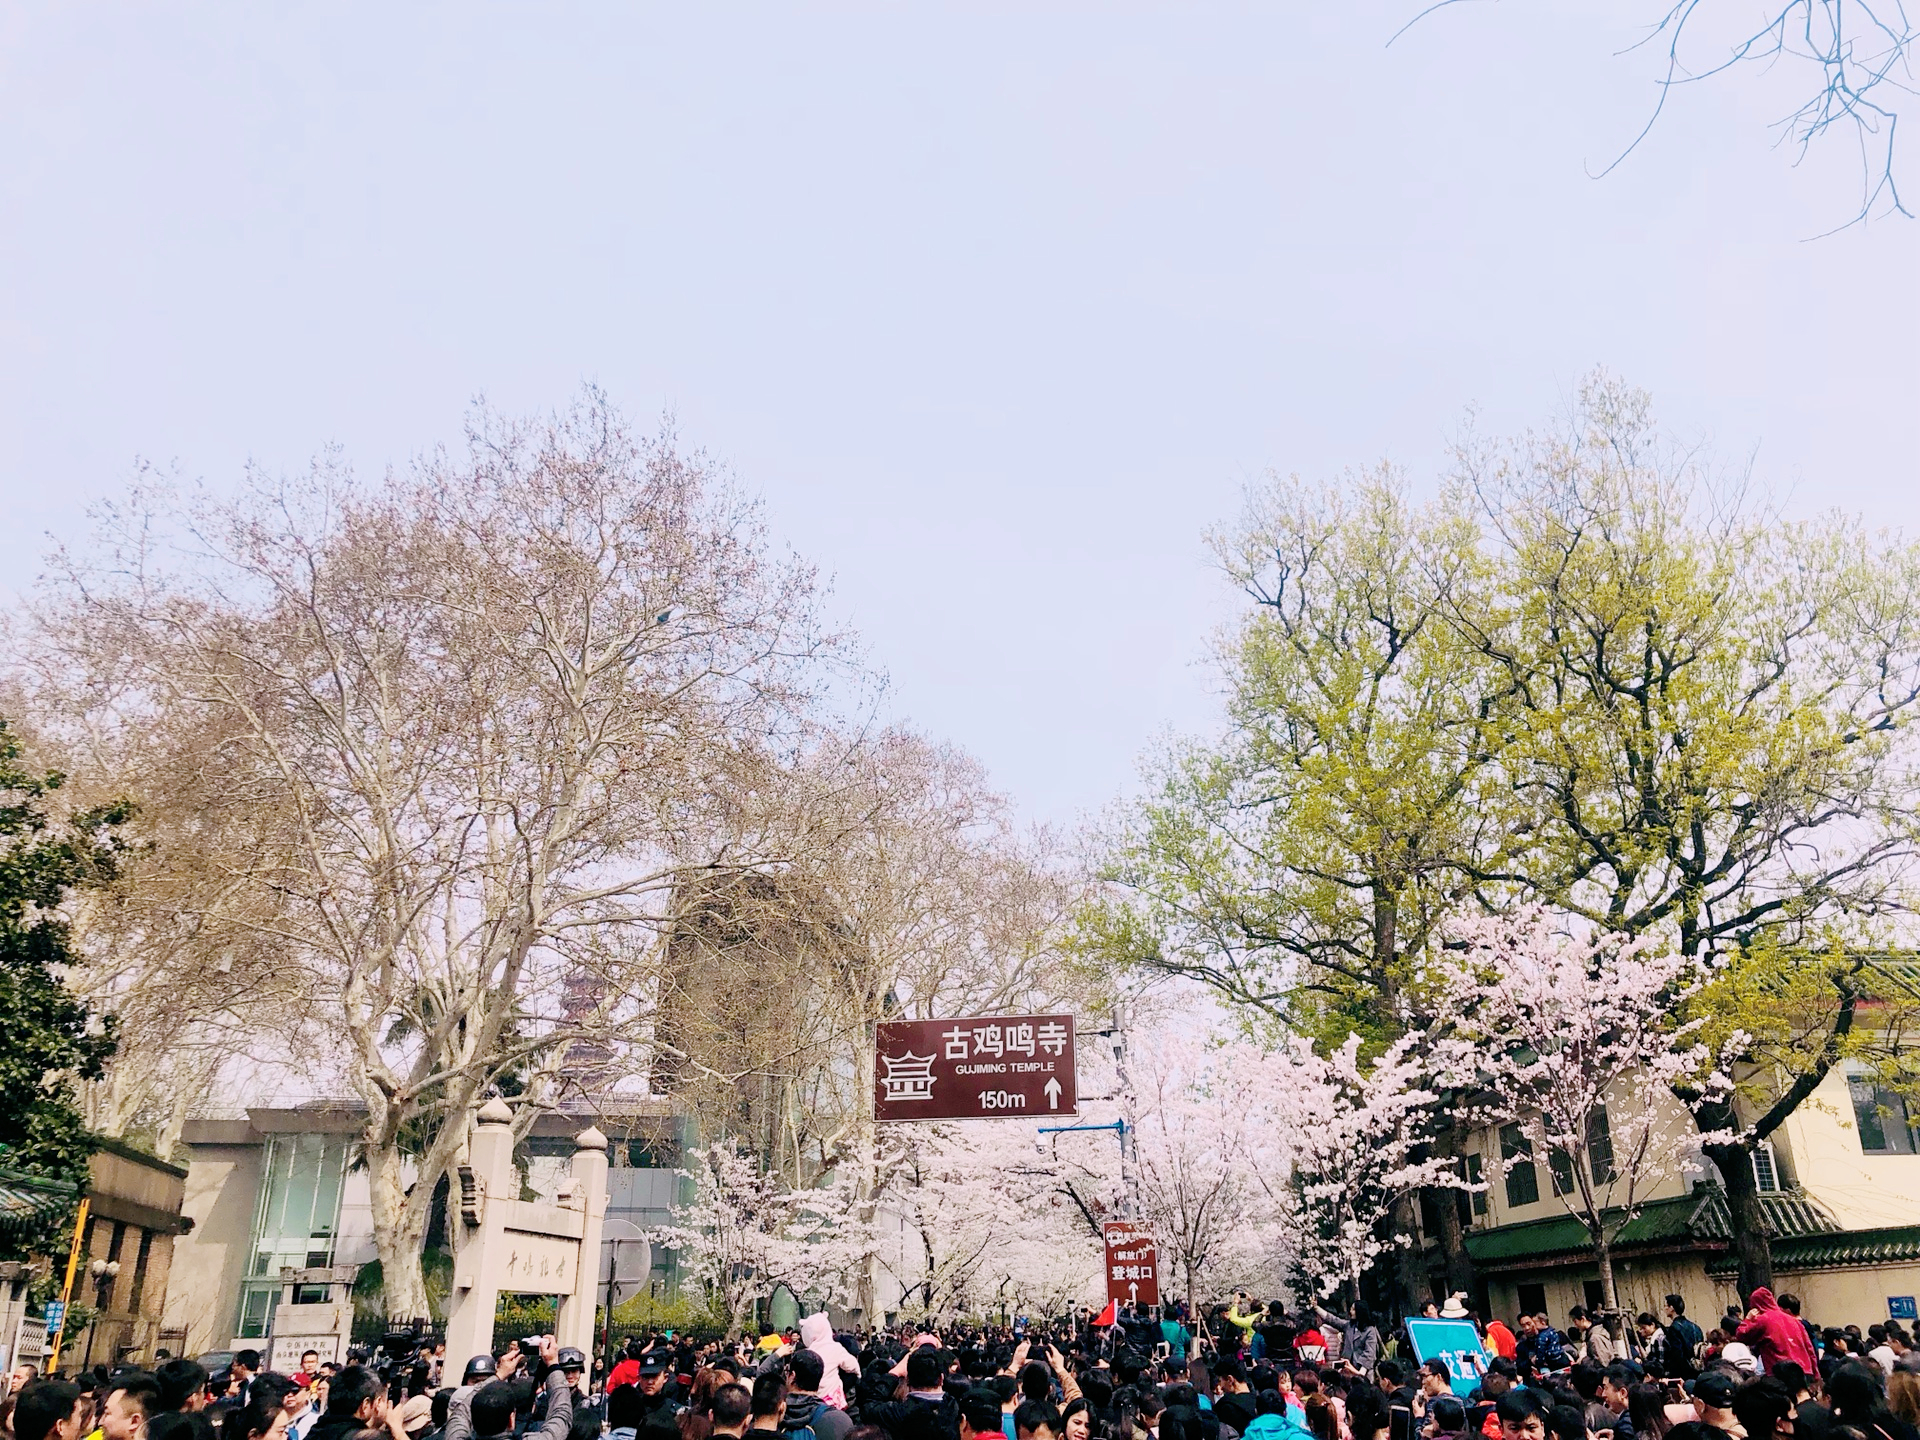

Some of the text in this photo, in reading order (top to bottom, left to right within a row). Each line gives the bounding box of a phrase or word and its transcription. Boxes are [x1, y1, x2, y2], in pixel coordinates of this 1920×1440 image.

[942, 1022, 1068, 1060] 古鸡鸣寺
[955, 1062, 1055, 1075] GUJIMING TEMPLE
[978, 1090, 1026, 1109] 150m
[1112, 1265, 1152, 1280] 登城口
